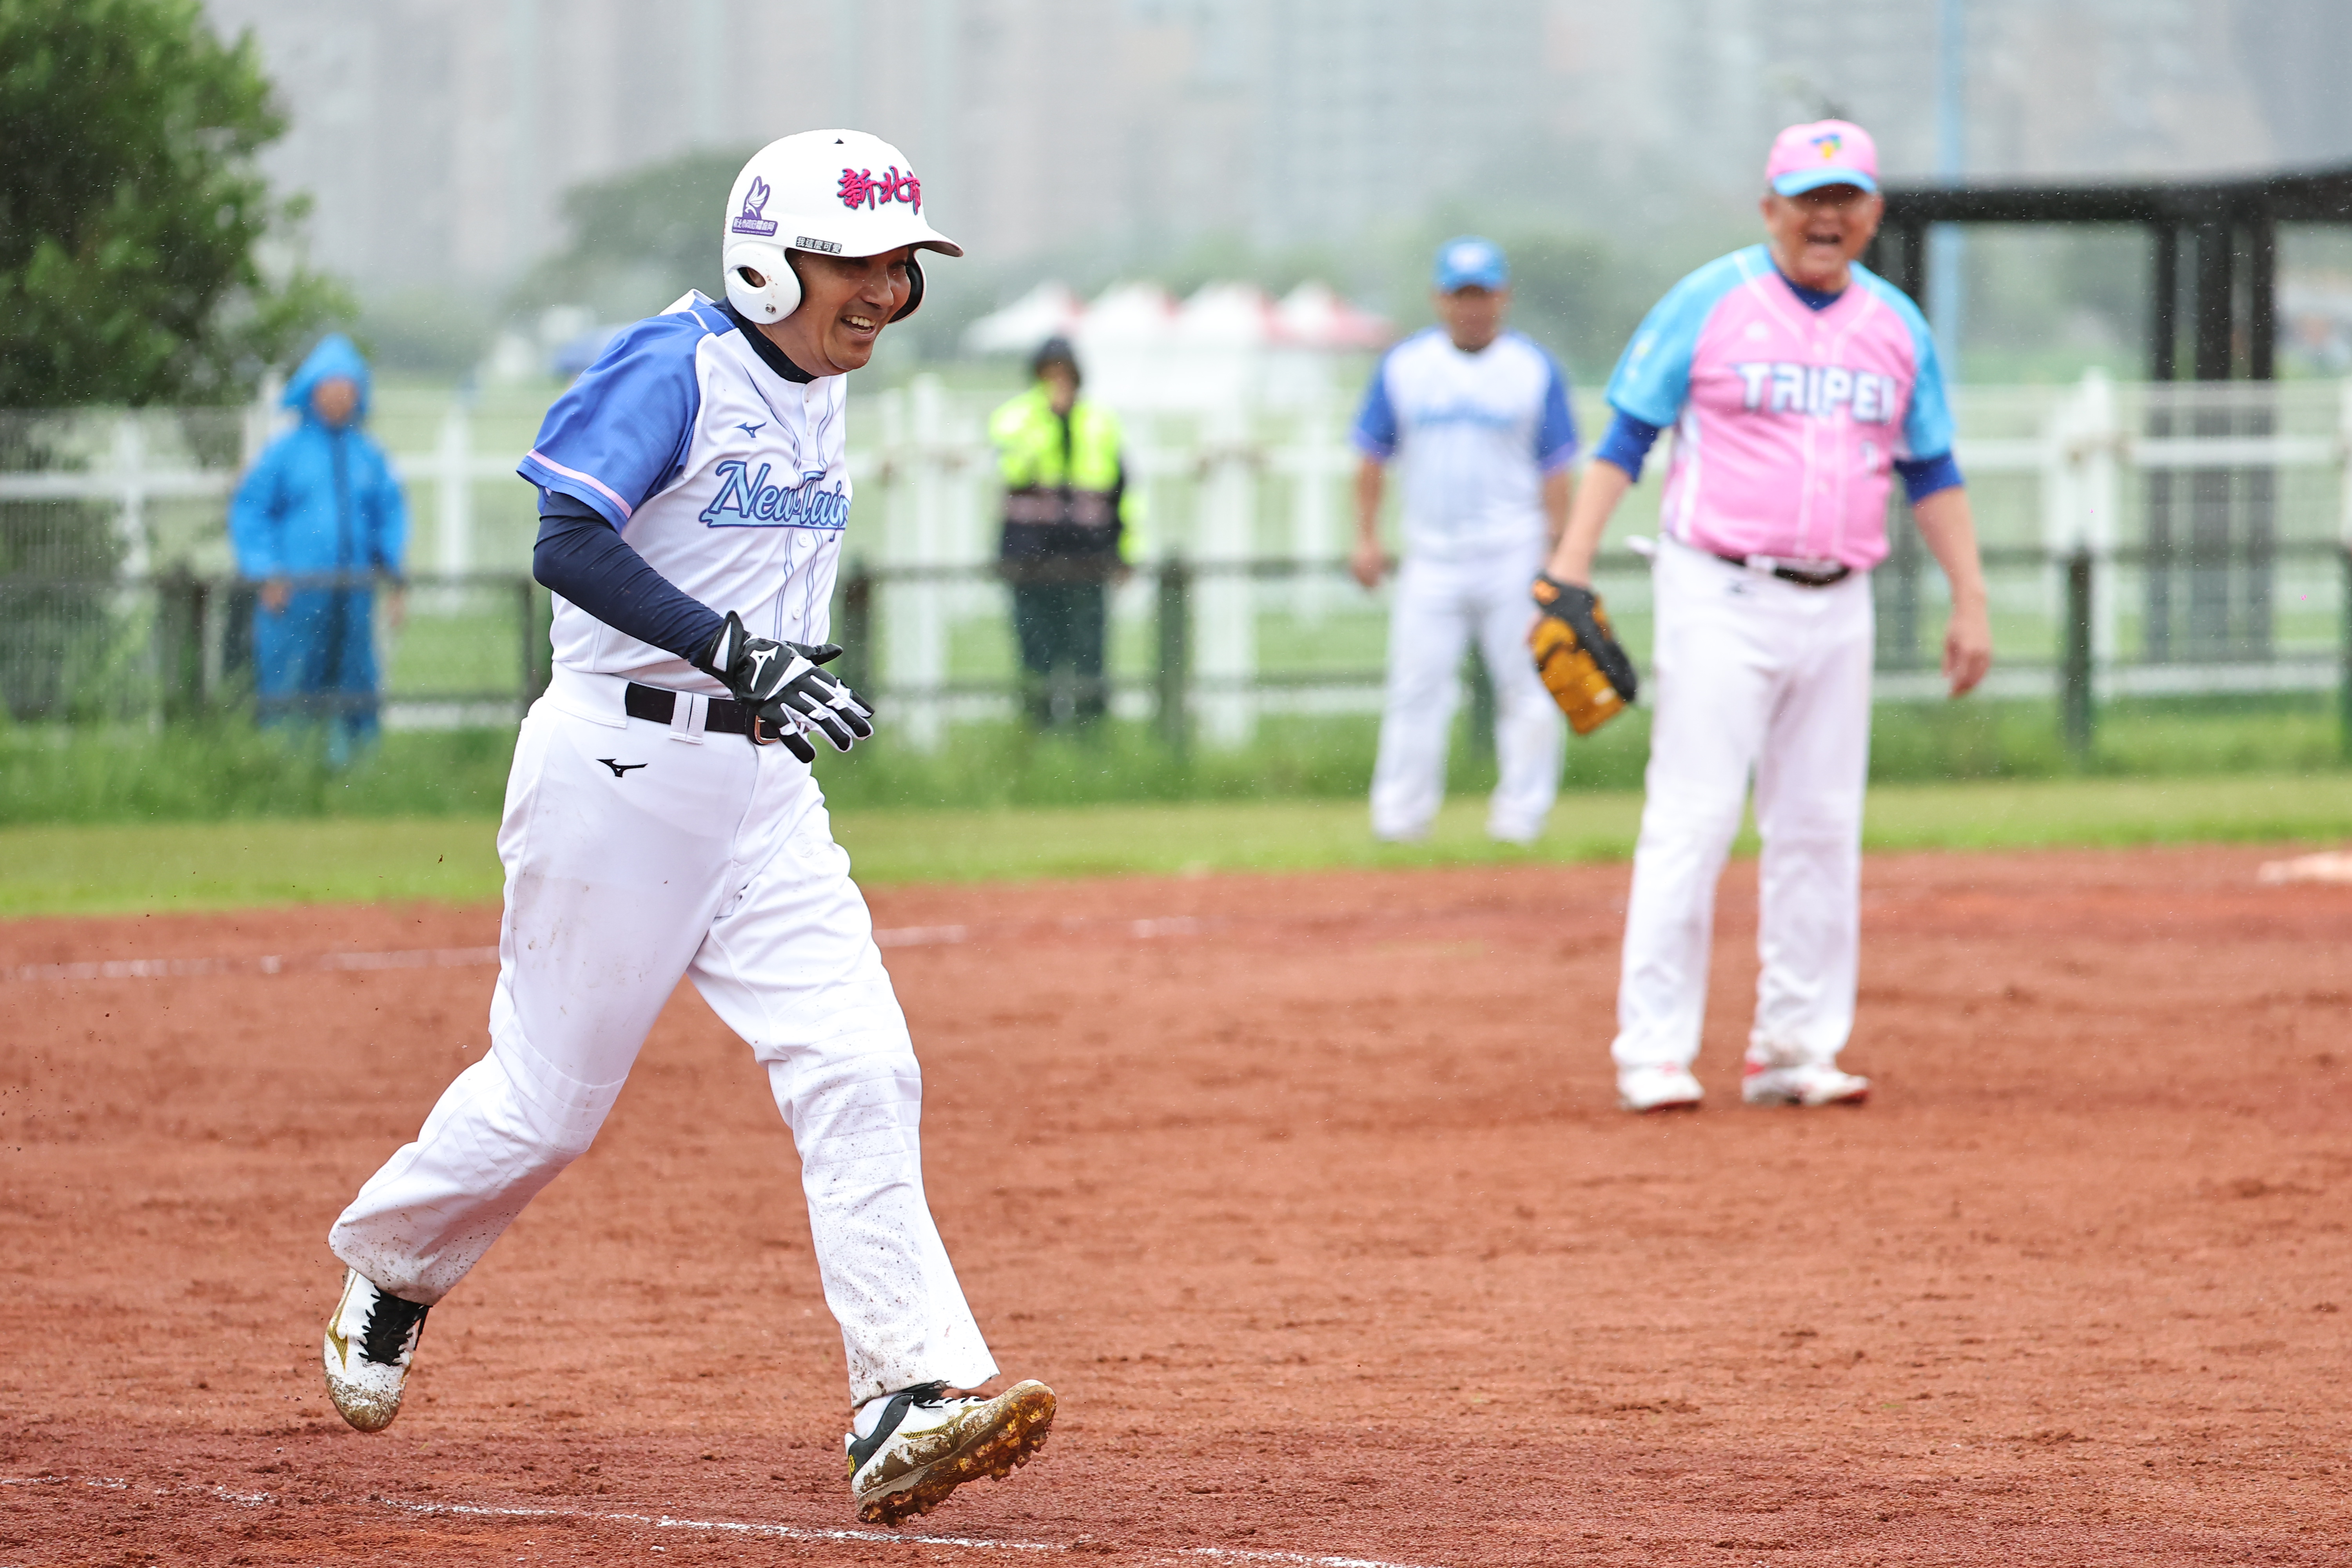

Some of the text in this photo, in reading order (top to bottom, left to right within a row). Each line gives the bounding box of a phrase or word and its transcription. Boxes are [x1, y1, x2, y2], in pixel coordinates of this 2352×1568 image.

[837, 165, 921, 215] 新北市
[797, 237, 841, 253] 我這麼可愛
[1730, 361, 1896, 422] TAIPEI
[709, 460, 801, 522] New
